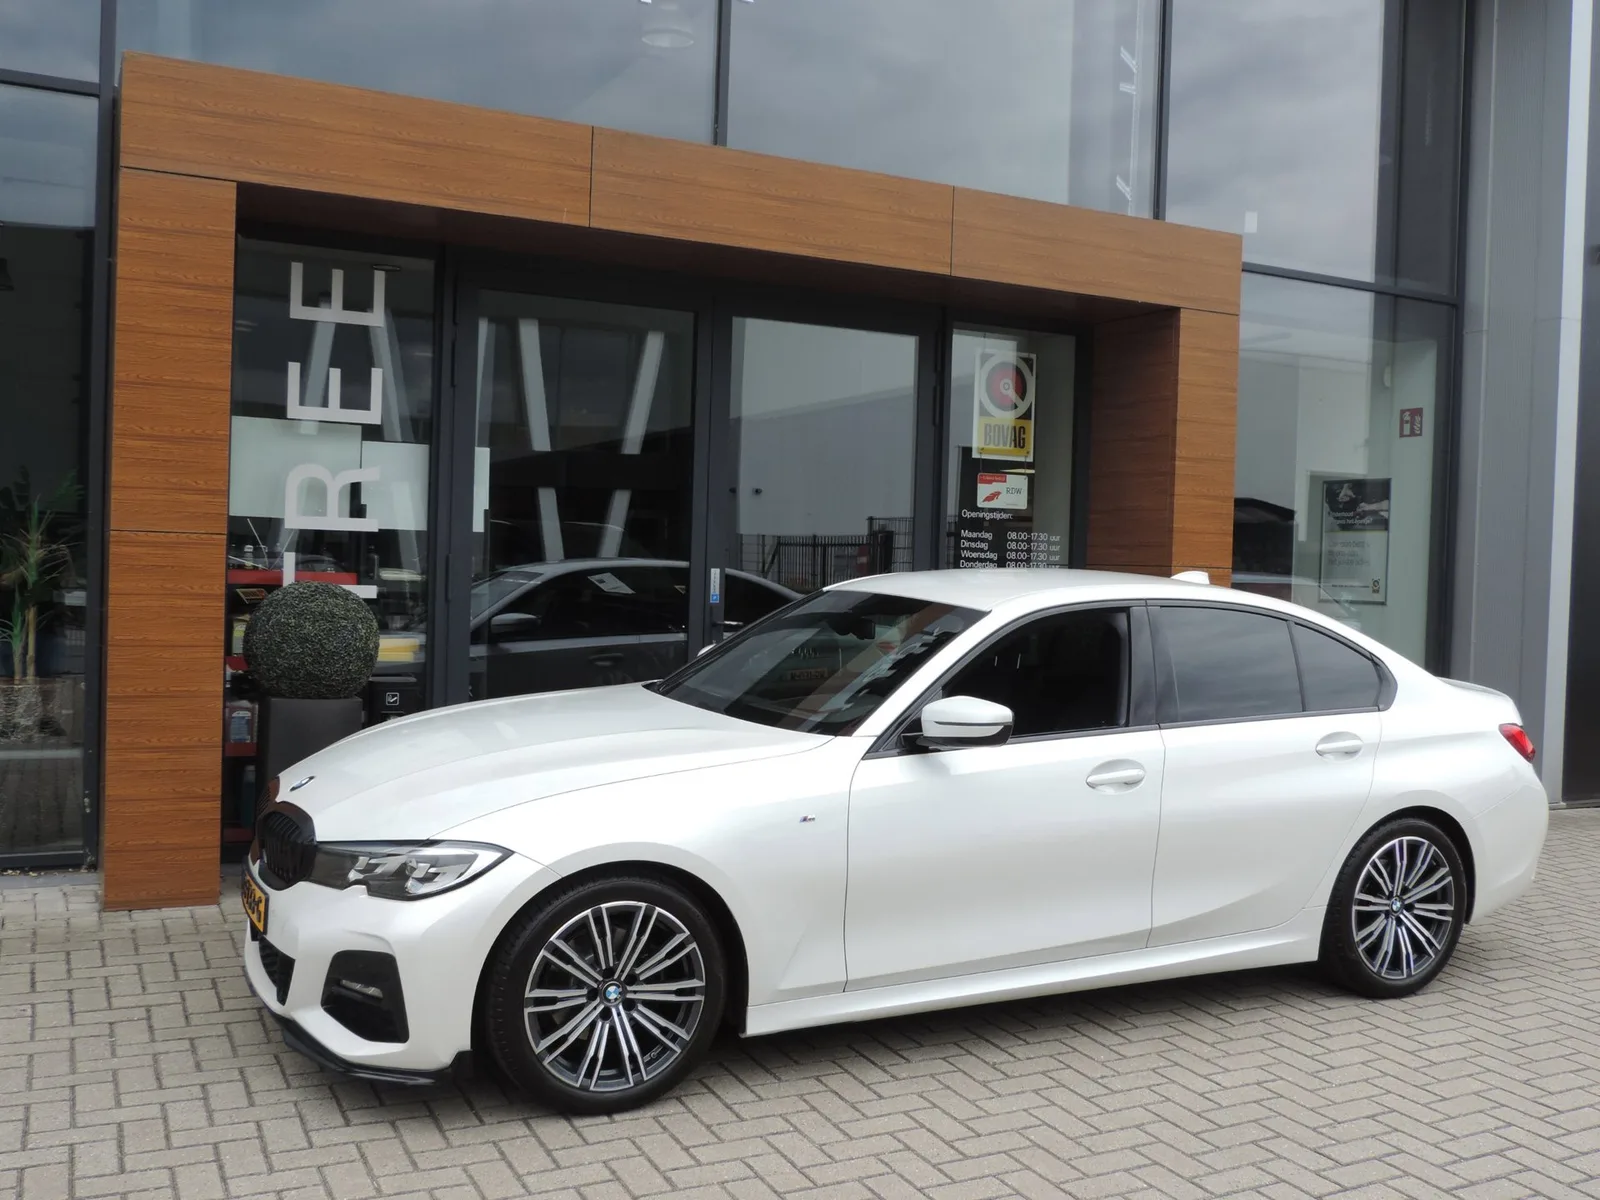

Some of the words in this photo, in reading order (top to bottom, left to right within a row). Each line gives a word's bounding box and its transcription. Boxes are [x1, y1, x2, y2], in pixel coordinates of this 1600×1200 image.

[983, 422, 1026, 449] BOVAG
[1005, 486, 1023, 495] RDW
[961, 509, 1014, 520] Openingstijden:
[960, 529, 993, 540] Maandag
[1006, 531, 1048, 541] 08.00-17.30
[960, 539, 989, 551] Dinsdag
[1006, 541, 1048, 551] 08.00-17.30
[960, 550, 998, 561] Woensdag
[1006, 551, 1048, 560] 08.00-17.30
[960, 560, 998, 568] Donderdag
